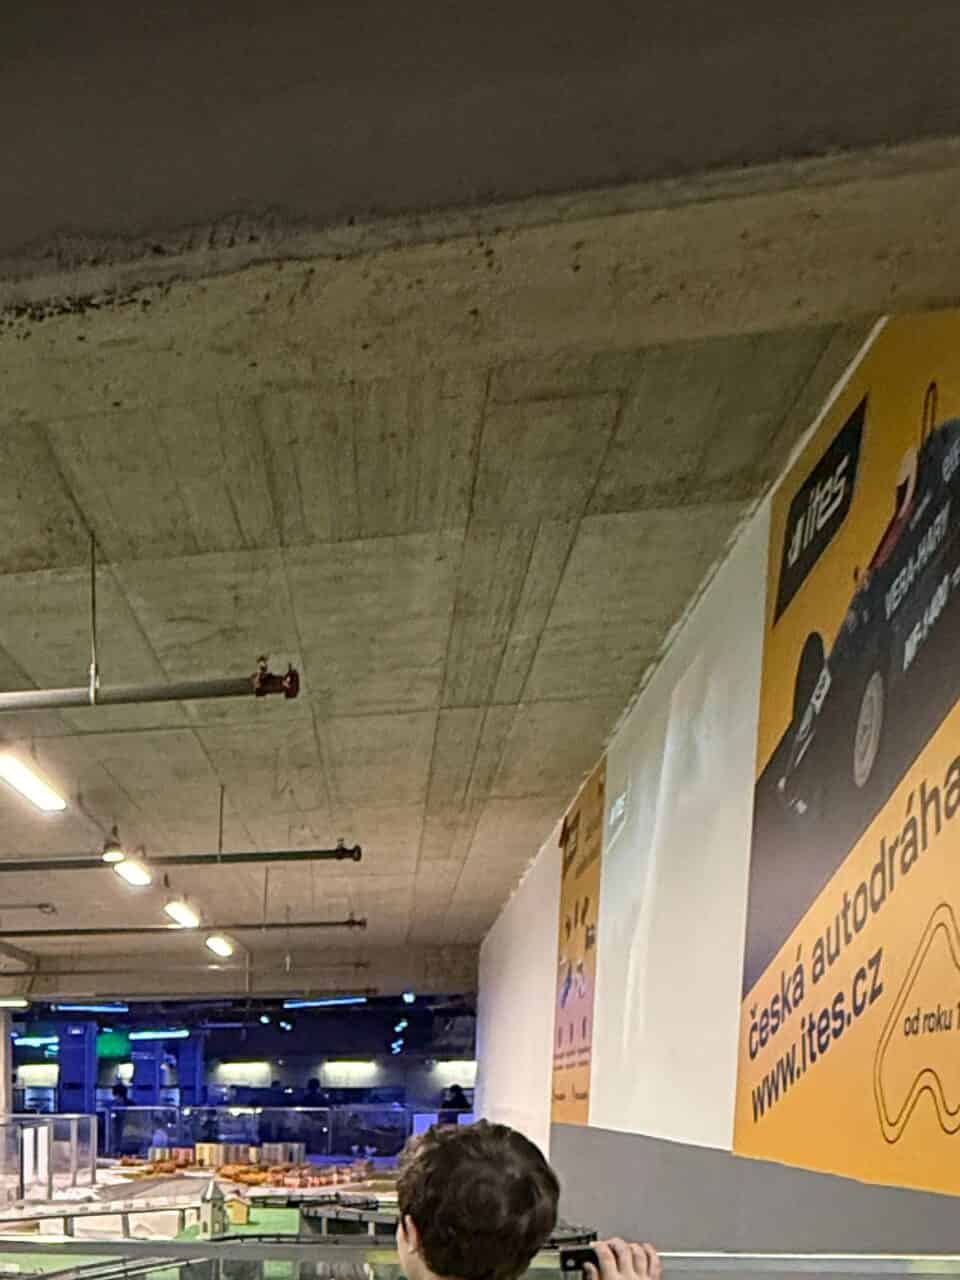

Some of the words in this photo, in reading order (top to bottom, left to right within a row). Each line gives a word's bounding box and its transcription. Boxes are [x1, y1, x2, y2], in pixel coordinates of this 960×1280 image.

[748, 943, 804, 1061] česká
[811, 754, 960, 985] autodráha
[751, 946, 884, 1124] www.ites.cz
[903, 1007, 920, 1036] od
[922, 1003, 953, 1033] roku
